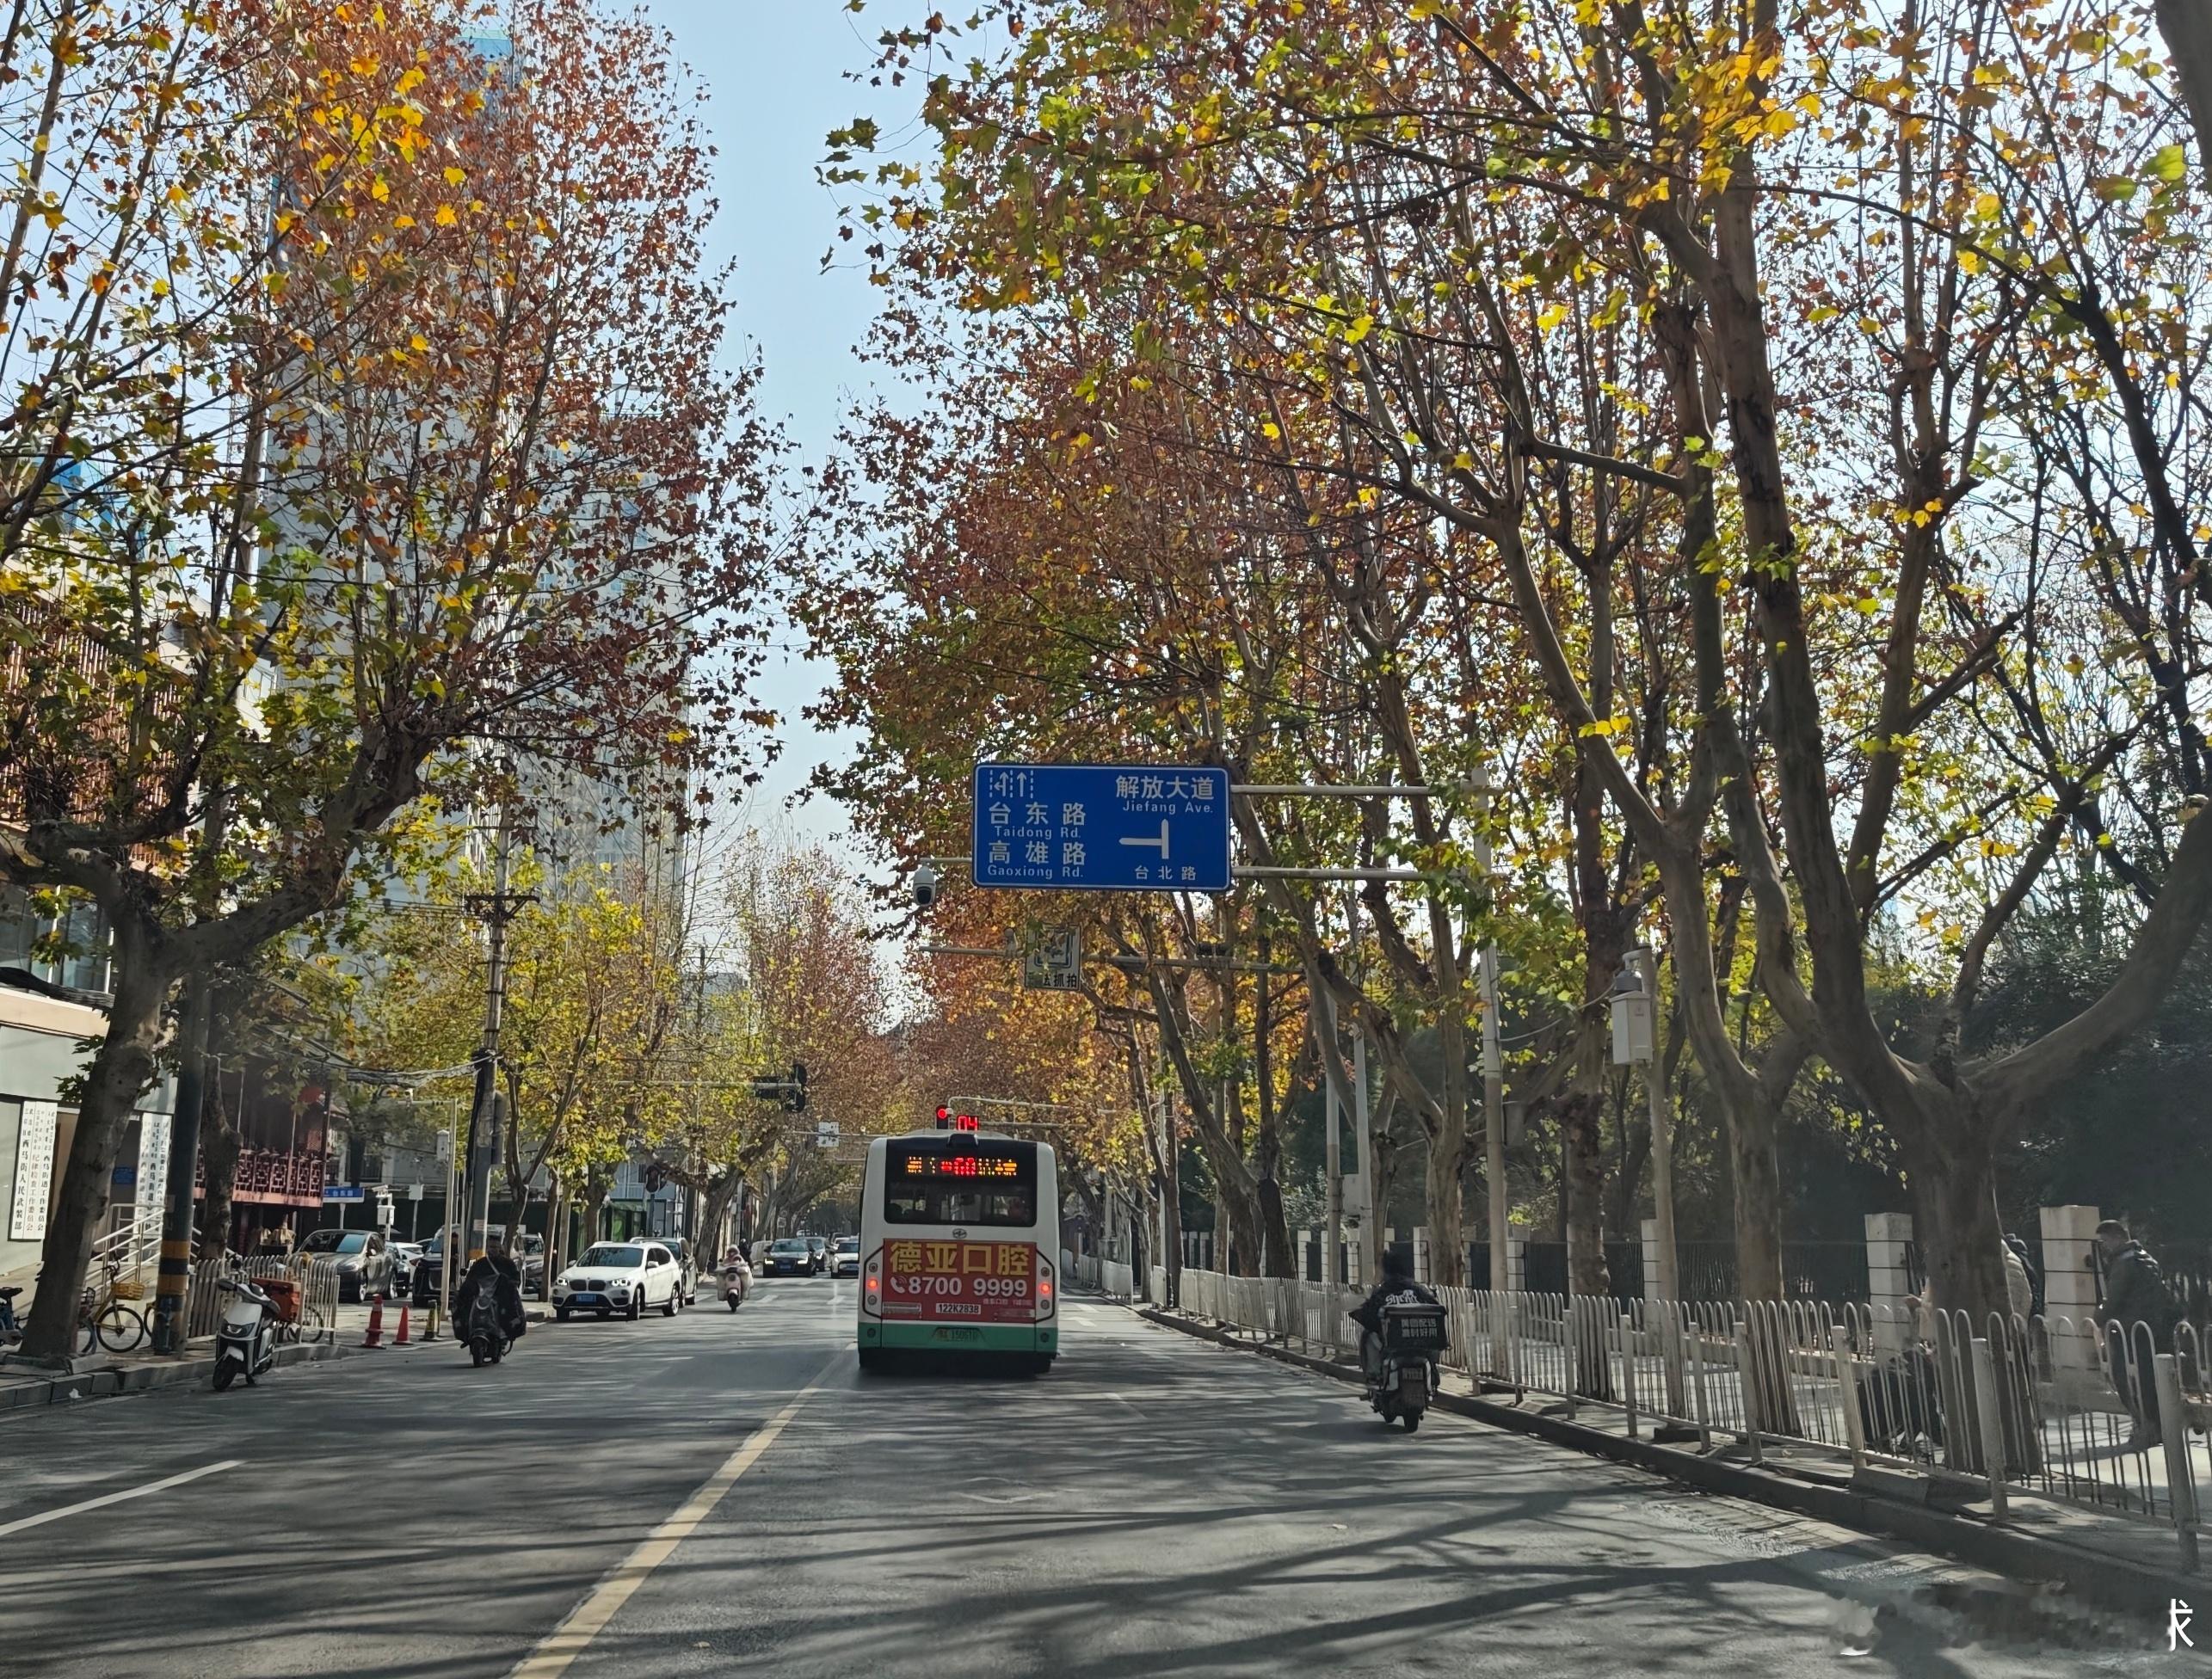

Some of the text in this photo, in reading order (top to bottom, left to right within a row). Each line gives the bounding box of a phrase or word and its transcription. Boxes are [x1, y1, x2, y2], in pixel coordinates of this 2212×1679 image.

[1116, 775, 1214, 800] 解放大道
[989, 802, 1086, 826] 台东路
[1123, 801, 1213, 815] Jiefang Ave.
[995, 826, 1052, 840] Taidong
[989, 840, 1086, 865] 高雄路
[988, 864, 1083, 879] Gaoxiong Rd.
[1135, 864, 1196, 881] 台北路
[890, 1241, 1030, 1276] 德亚口腔
[909, 1276, 1027, 1297] 8700 9999
